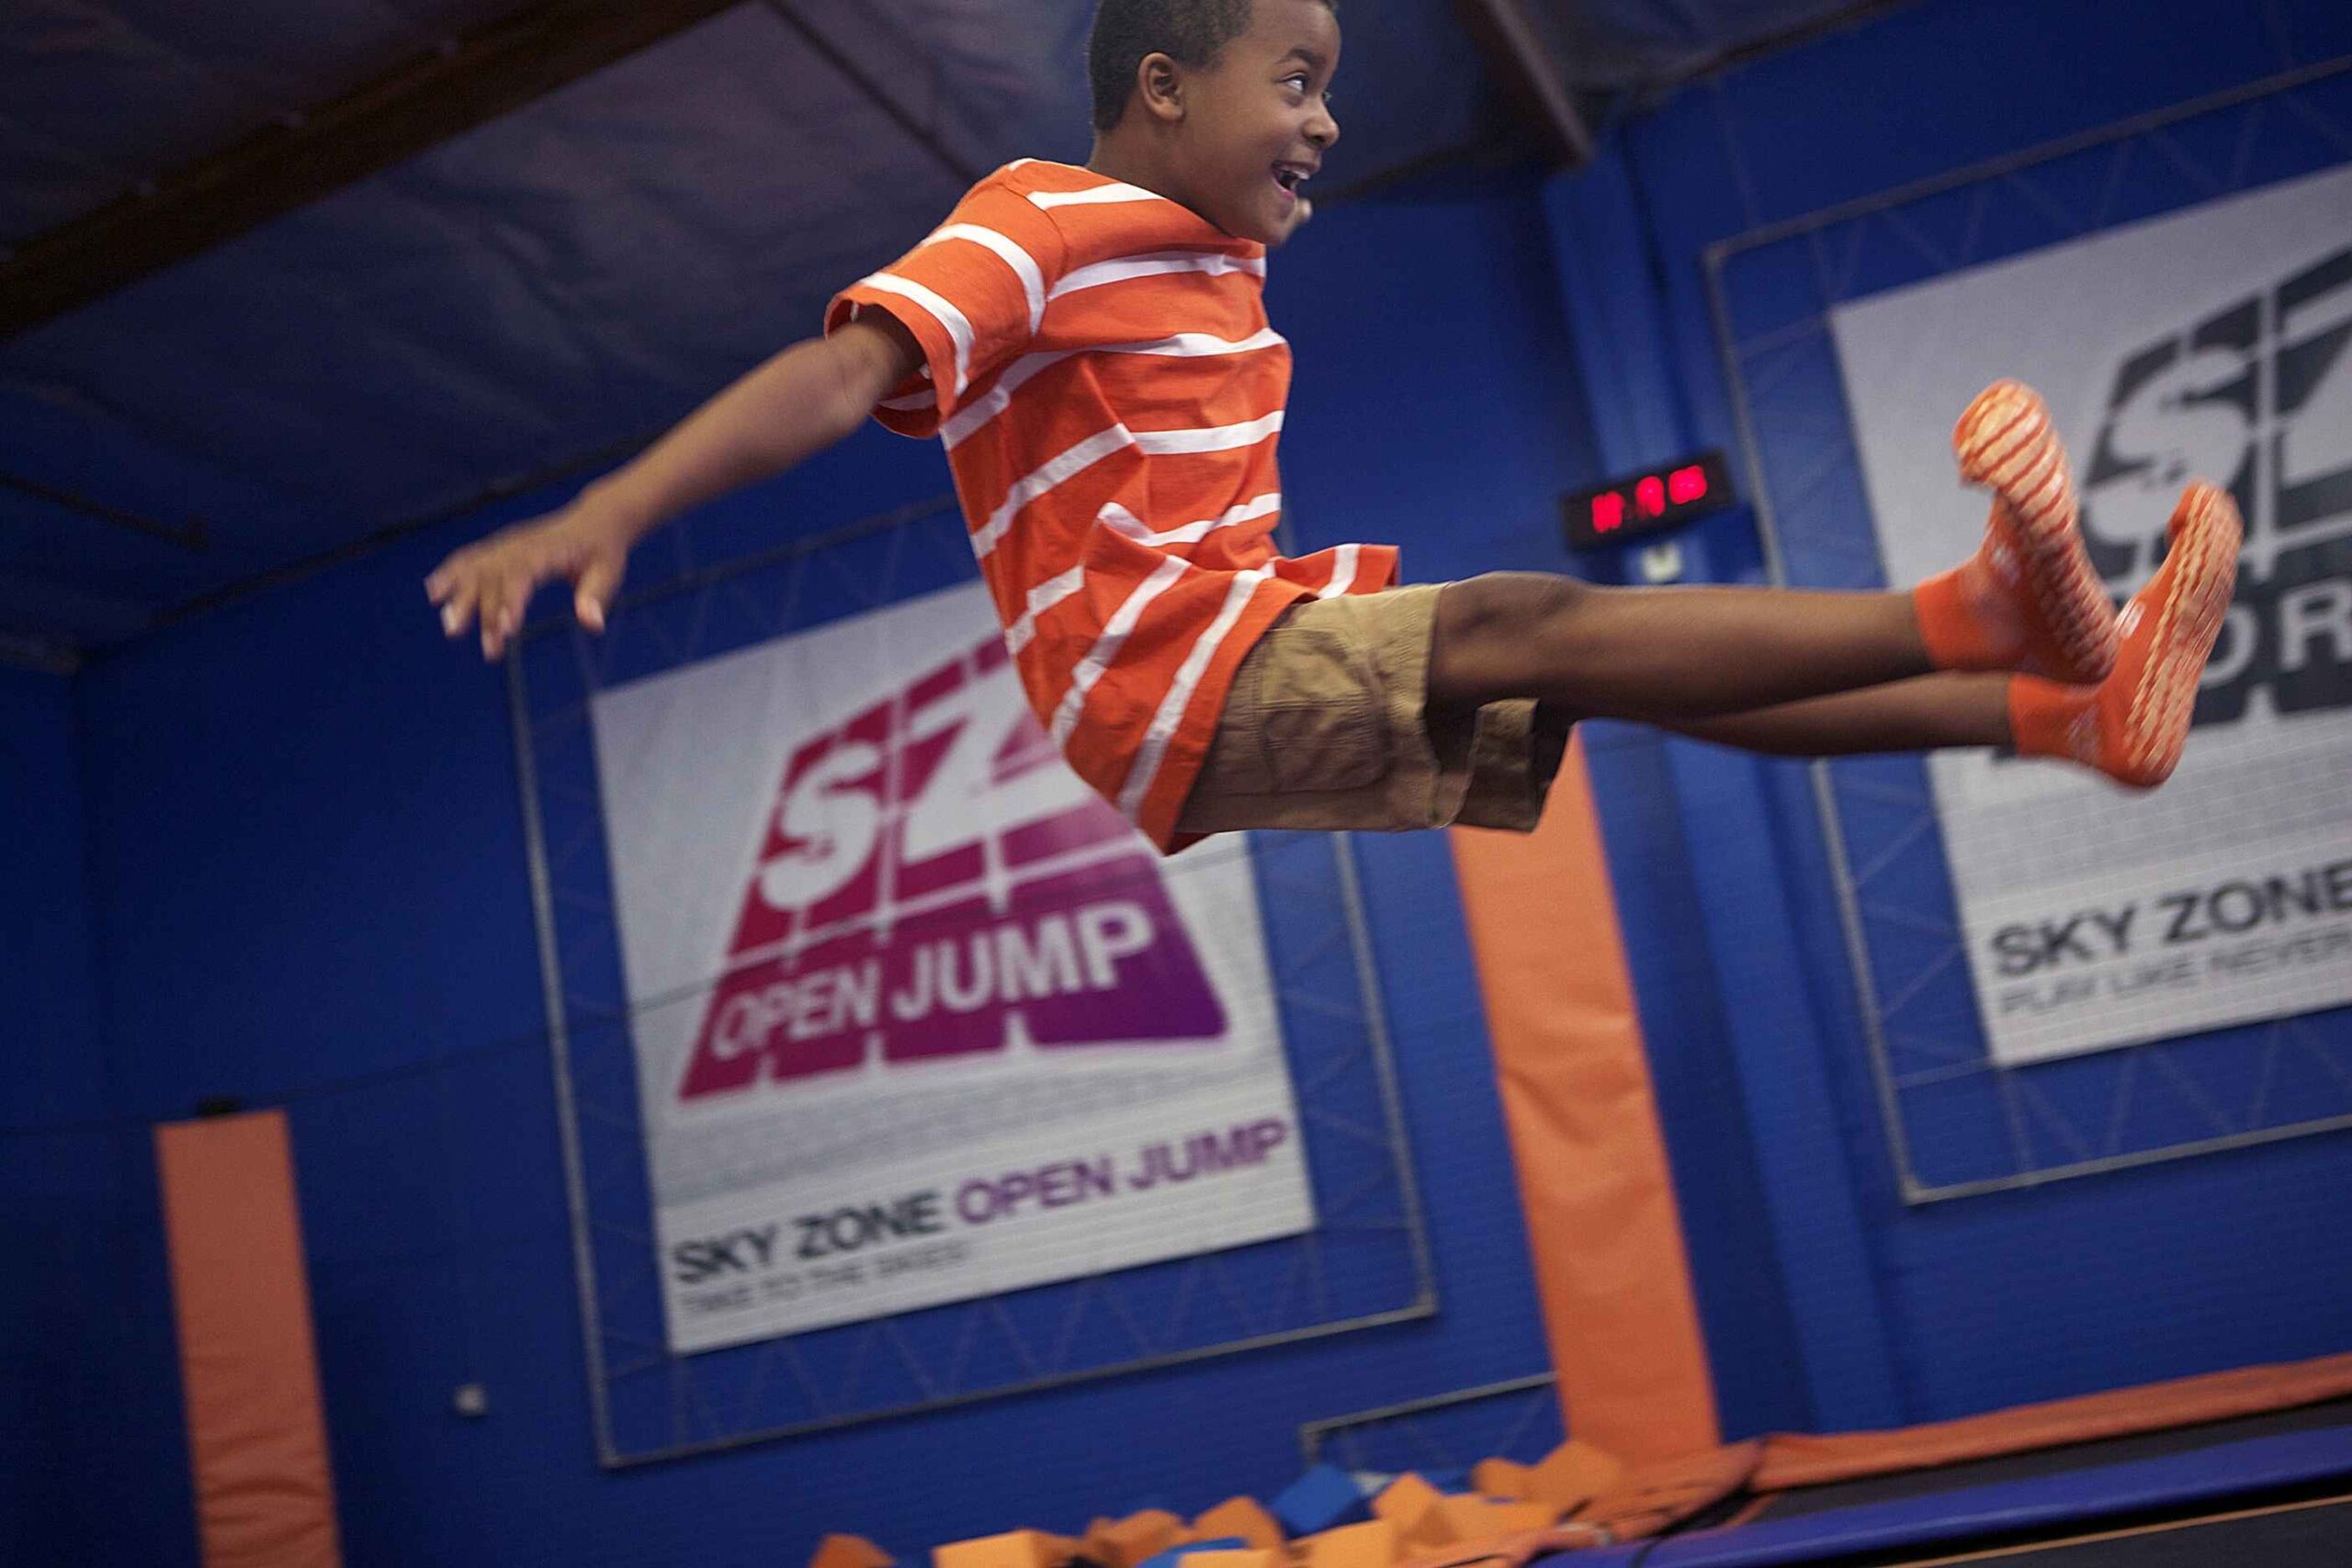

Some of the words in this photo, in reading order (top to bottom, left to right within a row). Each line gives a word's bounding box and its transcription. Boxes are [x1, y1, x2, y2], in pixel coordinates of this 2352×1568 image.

[712, 958, 882, 1061] OPEN
[891, 901, 1157, 1018] JUMP
[1991, 905, 2137, 978] SKY
[2158, 857, 2352, 946] ZONE
[673, 1223, 777, 1285] SKY
[793, 1191, 944, 1262] ZONE
[956, 1154, 1114, 1225] OPEN
[1128, 1116, 1287, 1191] JUMP
